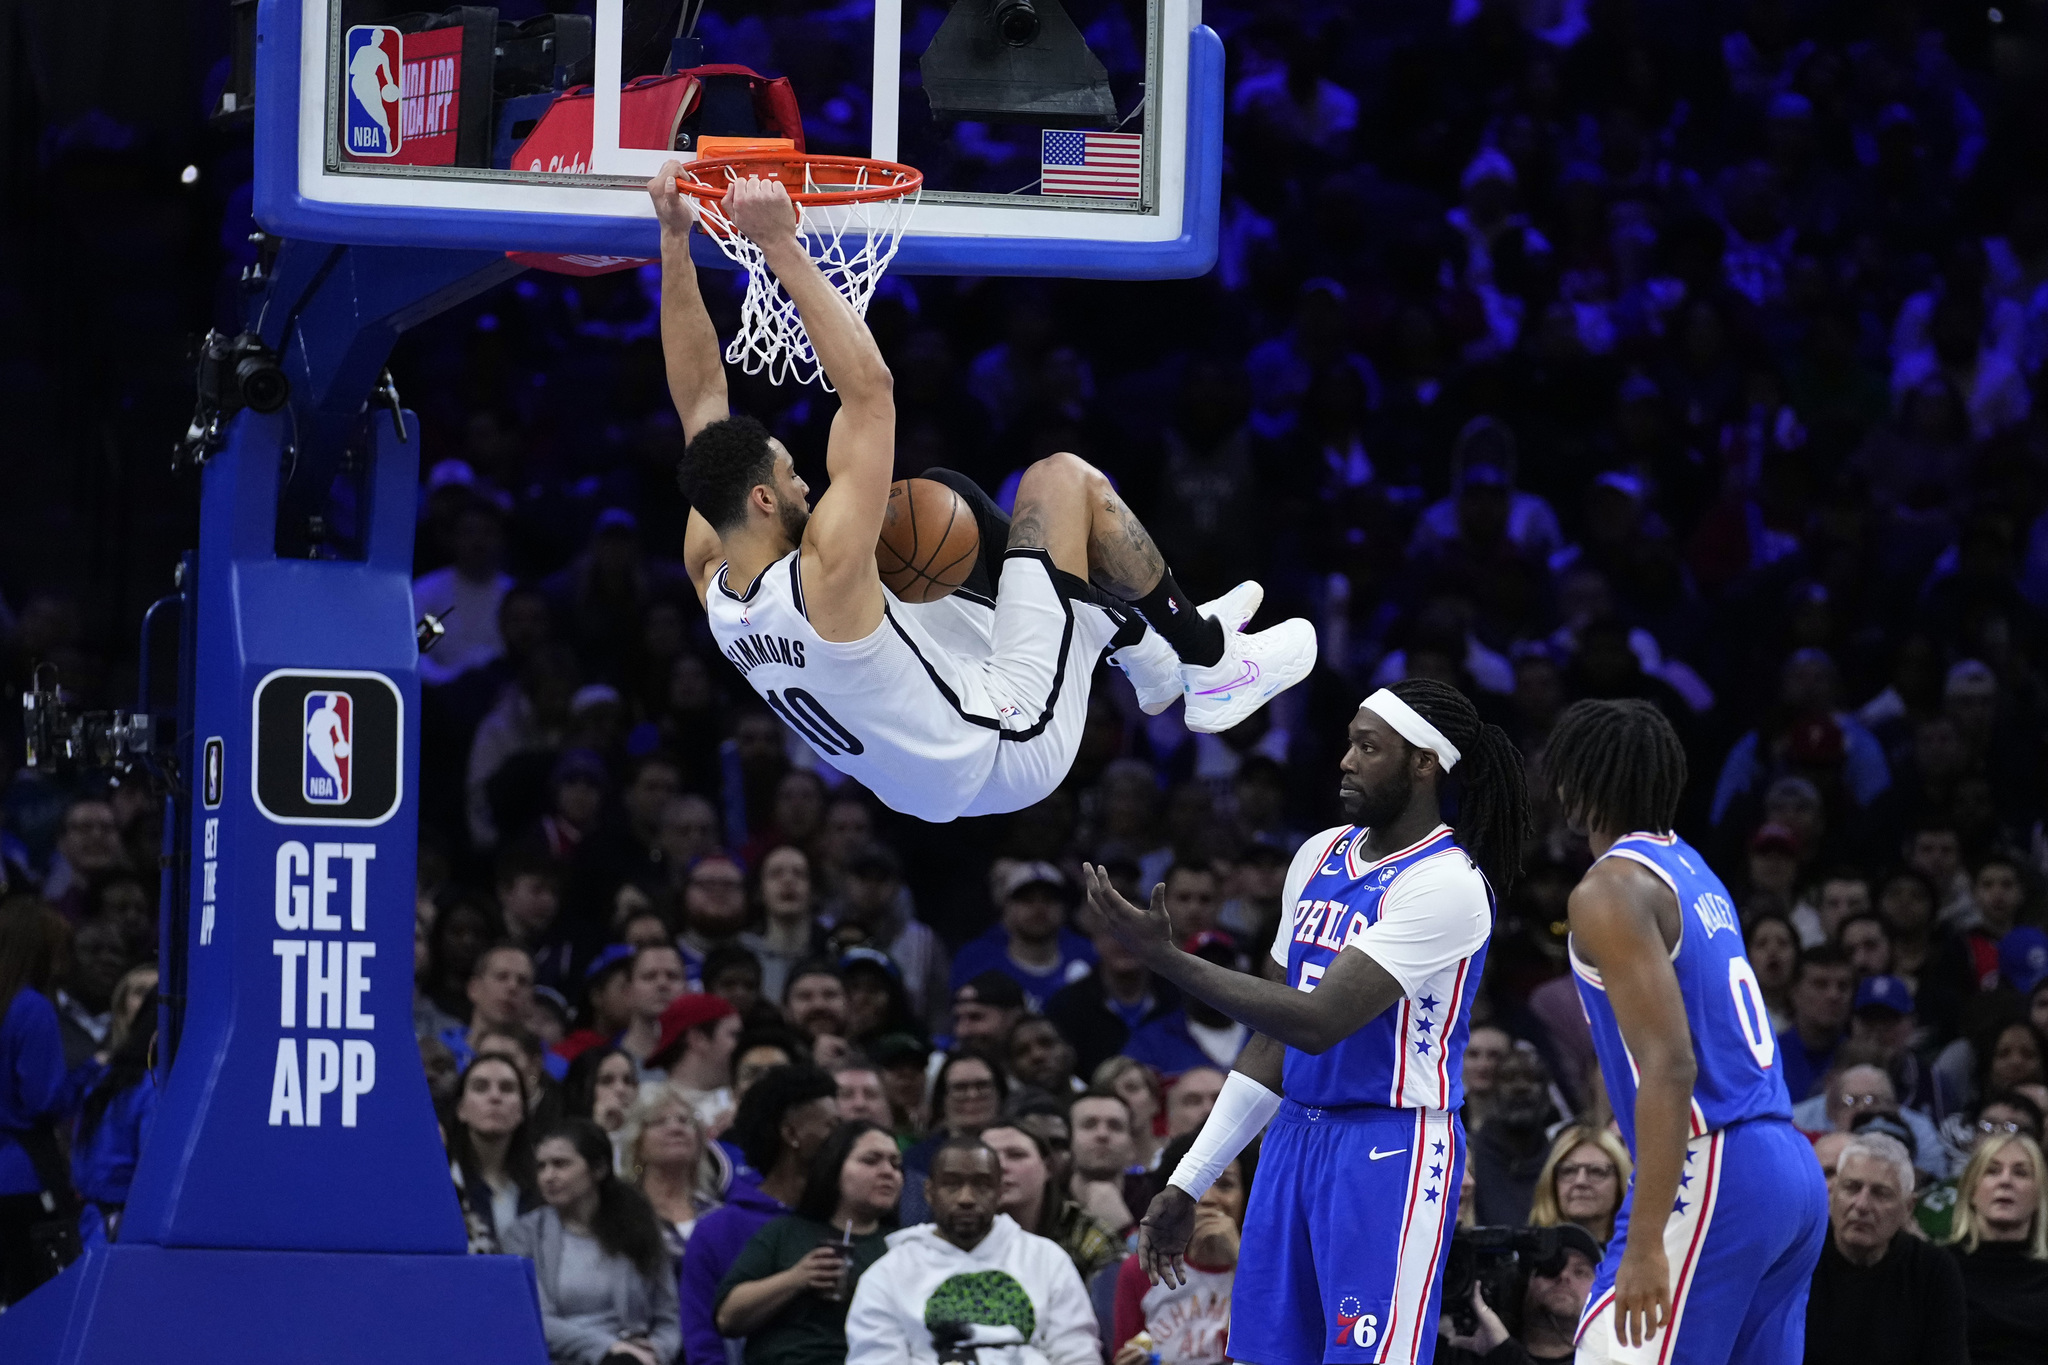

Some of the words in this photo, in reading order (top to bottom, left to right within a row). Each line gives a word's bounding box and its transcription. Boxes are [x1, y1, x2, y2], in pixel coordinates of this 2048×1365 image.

[425, 57, 455, 138] APP
[353, 126, 380, 148] NBA
[727, 634, 806, 677] SIMMONS
[766, 687, 865, 756] 10
[310, 776, 334, 797] NBA
[1335, 840, 1349, 855] 6
[275, 840, 377, 932] GET
[273, 939, 377, 1030] THE
[1729, 956, 1775, 1070] 0
[268, 1037, 377, 1128] APP
[1336, 1312, 1378, 1349] 76
